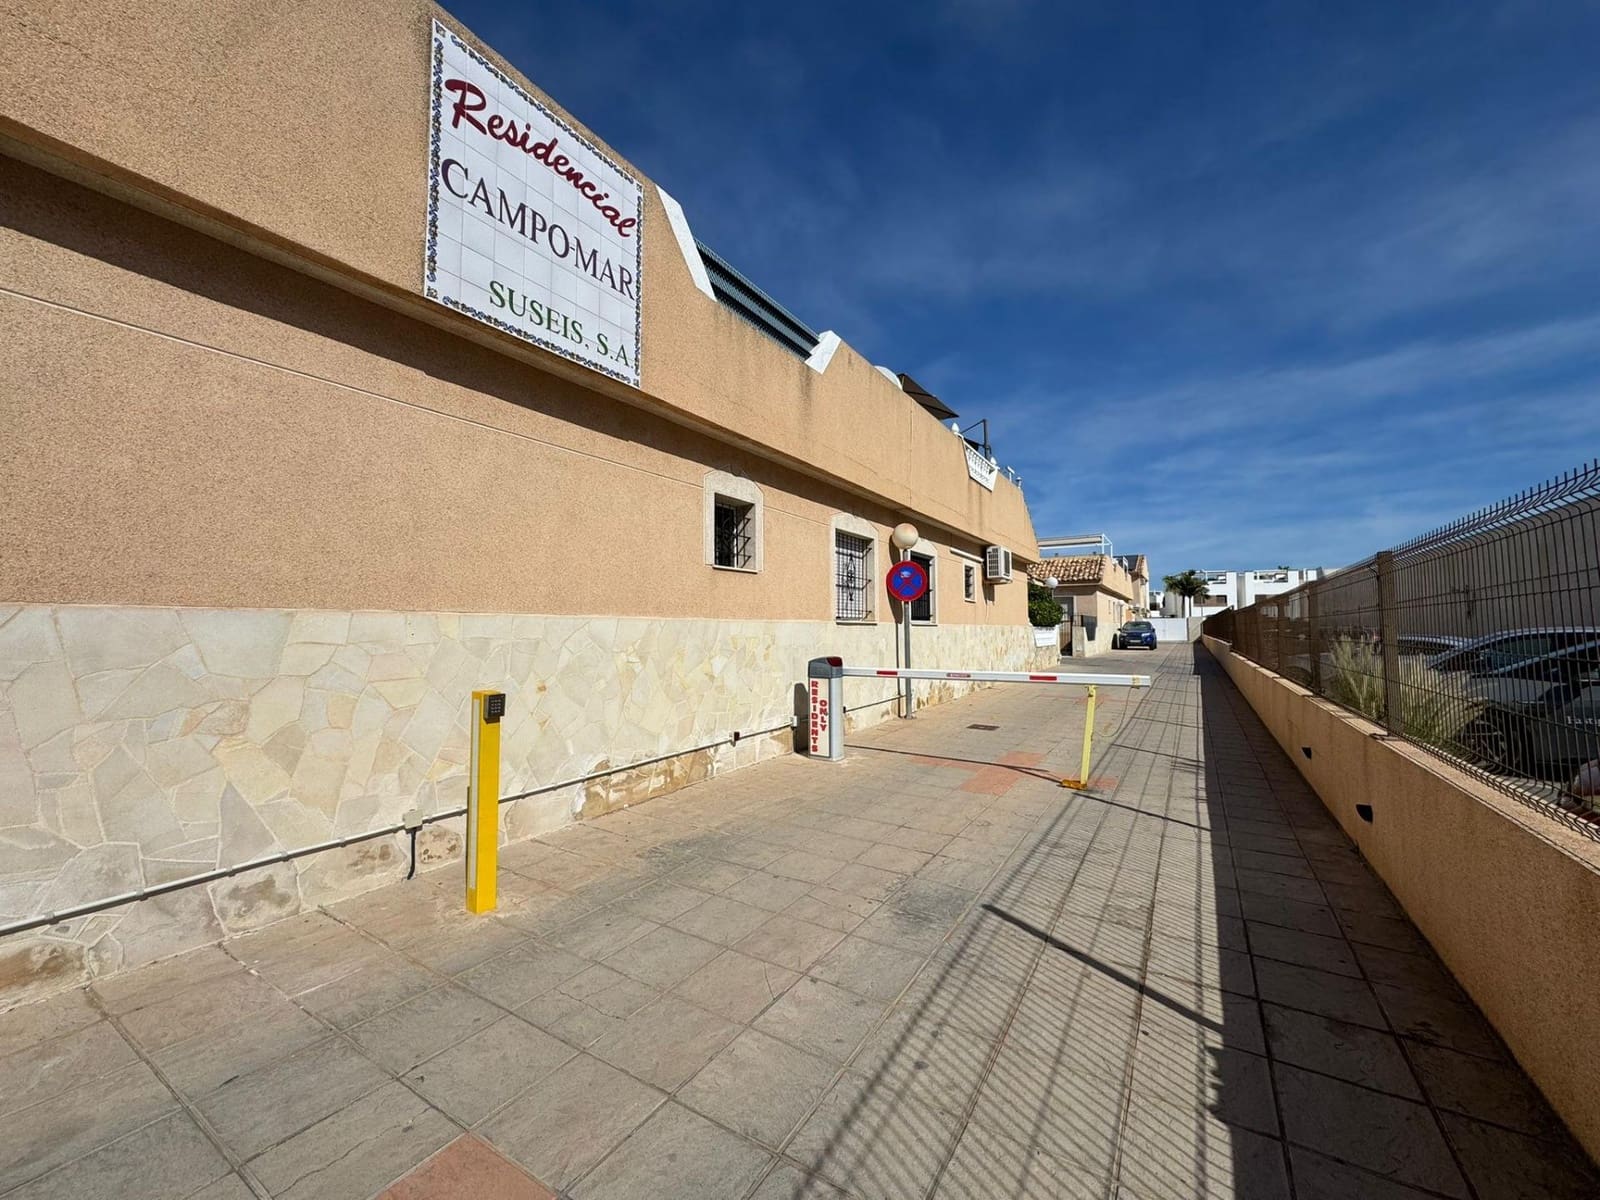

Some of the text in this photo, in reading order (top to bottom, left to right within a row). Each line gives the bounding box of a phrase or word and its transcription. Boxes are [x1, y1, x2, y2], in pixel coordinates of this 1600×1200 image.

[444, 79, 636, 237] Residencial
[441, 158, 634, 300] CAMPO-MAR
[596, 332, 634, 369] S.A.
[811, 680, 819, 753] RESIDENTS
[819, 699, 828, 732] ONLY
